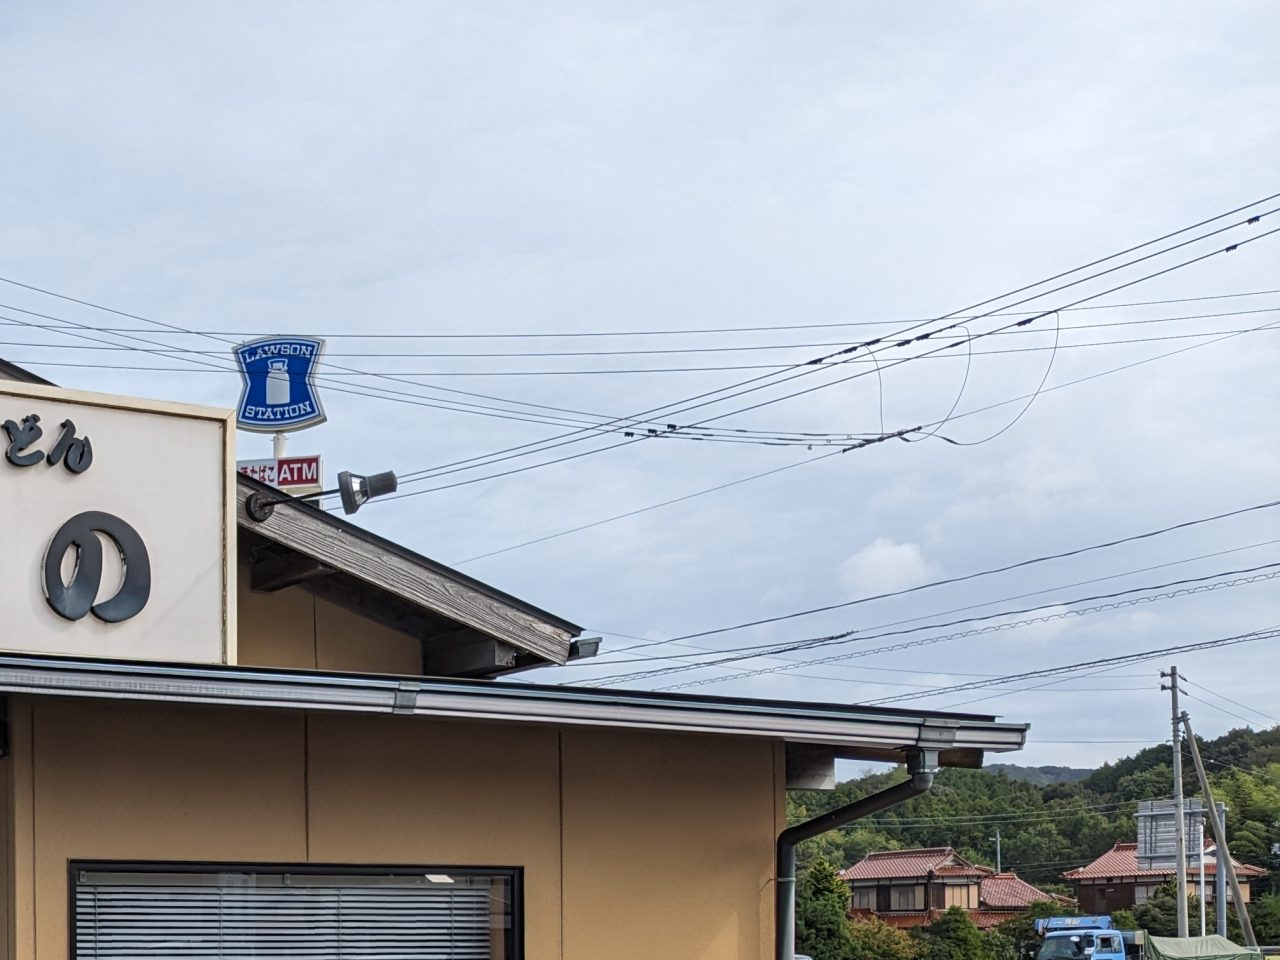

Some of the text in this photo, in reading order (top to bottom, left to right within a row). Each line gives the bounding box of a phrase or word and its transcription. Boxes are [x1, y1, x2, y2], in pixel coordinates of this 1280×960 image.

[245, 344, 313, 363] LAWSON
[245, 401, 312, 419] STATION
[279, 462, 317, 482] ATM
